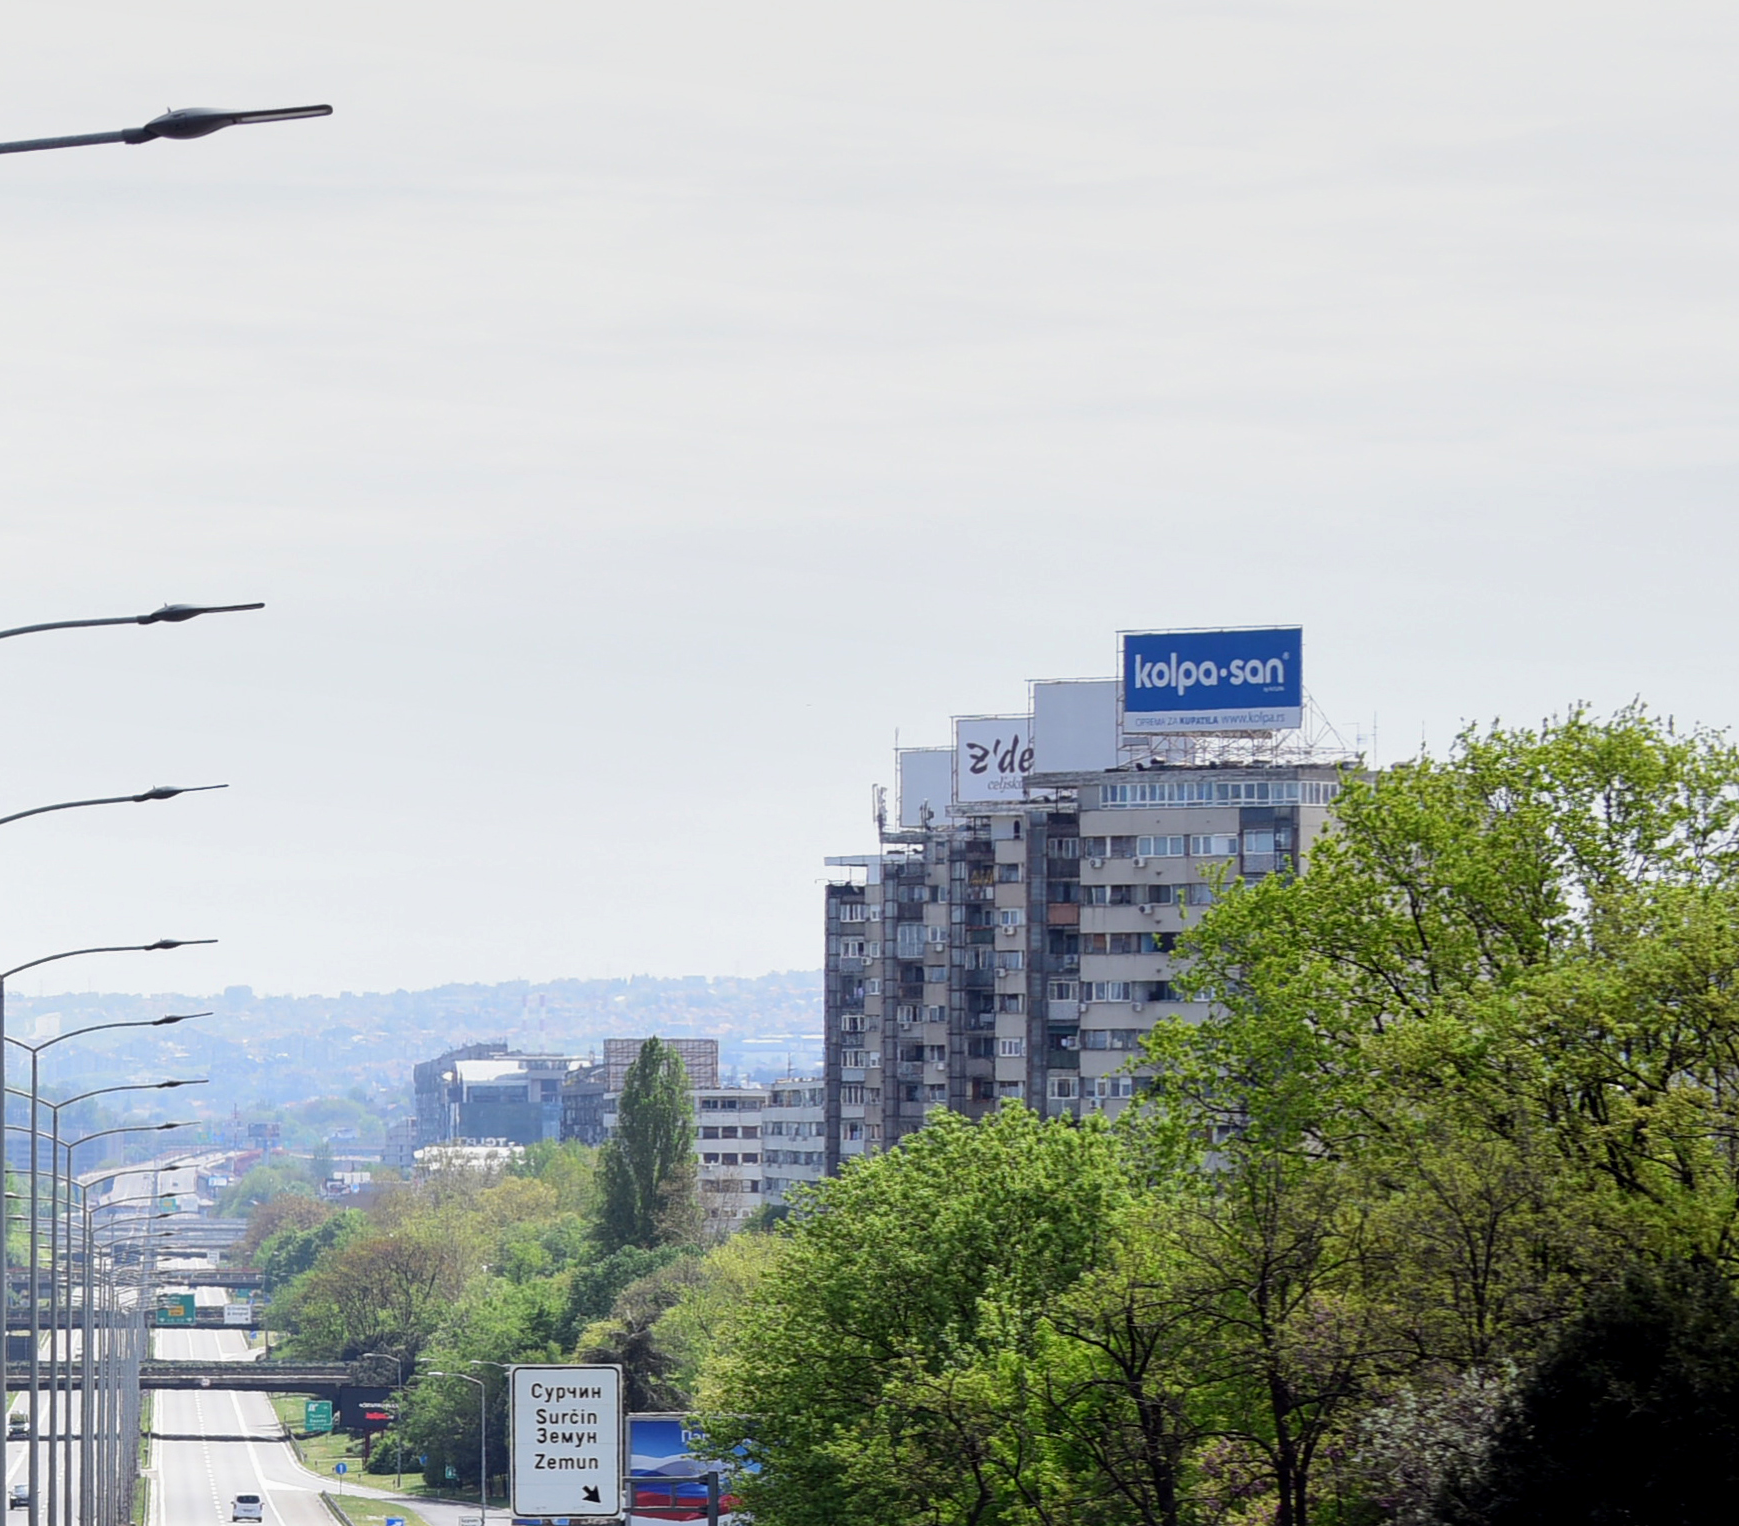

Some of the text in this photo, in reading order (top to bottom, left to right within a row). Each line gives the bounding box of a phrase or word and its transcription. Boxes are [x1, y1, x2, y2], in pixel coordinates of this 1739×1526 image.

[1180, 716, 1219, 726] KUPATILA
[1221, 711, 1286, 725] www.kolpa.rs
[531, 1383, 602, 1403] Сурчин
[536, 1408, 598, 1425] Surčin
[536, 1427, 598, 1448] Земун
[534, 1453, 599, 1470] Zemun
